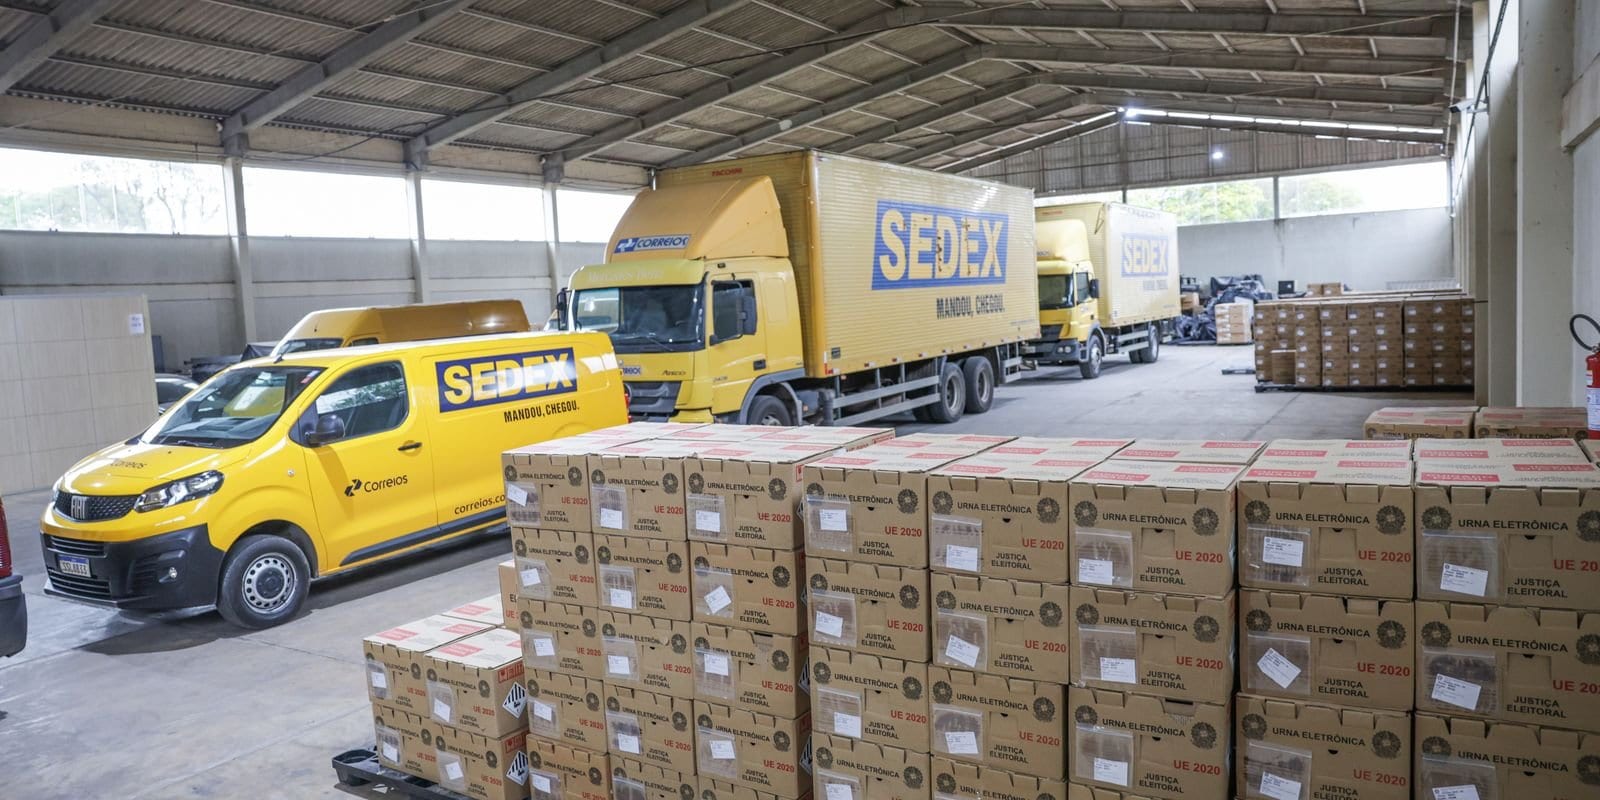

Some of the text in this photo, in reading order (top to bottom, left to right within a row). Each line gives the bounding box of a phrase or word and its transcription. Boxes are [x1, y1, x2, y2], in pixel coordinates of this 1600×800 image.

[636, 236, 690, 249] CORREIOS
[880, 209, 1003, 281] SEDEX
[1122, 239, 1168, 273] SEDEX
[936, 294, 1005, 319] MANDOU, CHEGOU.
[444, 352, 572, 405] SEDEX
[504, 400, 580, 423] MANDOU, CHEGOU.
[520, 472, 533, 480] URNA
[364, 474, 408, 493] Correios
[624, 479, 659, 487] ELETRÔNICA
[708, 482, 765, 492] URNA ELETRÔNICA
[454, 494, 506, 515] correios.co
[572, 497, 588, 505] 2020
[849, 494, 893, 504] ELETRÔNICA
[71, 496, 86, 519] FIAT
[666, 506, 683, 515] 2020
[957, 502, 1032, 514] URNA ELETRÔNICA
[759, 512, 791, 523] UE 2020
[1103, 512, 1187, 525] URNA ELETRÔNICA
[1276, 512, 1370, 524] URNA ELETRÔNICA
[634, 524, 661, 532] ELEITORAL
[738, 525, 762, 533] JUSTIÇA
[1458, 519, 1568, 531] URNA ELETRÔNICA
[735, 532, 766, 540] ELEITORAL
[885, 527, 922, 537] UE 2020
[863, 541, 890, 549] JUSTIÇA
[1022, 538, 1064, 550] UE 2020
[859, 548, 894, 557] ELEITORAL
[996, 552, 1027, 561] JUSTIÇA
[1176, 551, 1223, 563] UE 2020
[1359, 551, 1411, 563] UE 2020
[992, 560, 1031, 570] ELEITORAL
[1146, 566, 1181, 576] JUSTIÇA
[1554, 560, 1600, 572] UE 20
[730, 567, 769, 579] ELETRÔNICA
[1324, 567, 1363, 578] JUSTIÇA
[1140, 574, 1185, 585] ELEITORAL
[1318, 576, 1369, 586] ELEITORAL
[1514, 578, 1560, 588] JUSTIÇA
[659, 583, 687, 593] UE 2020
[831, 585, 895, 599] URNA ELETRÔNICA
[1508, 587, 1567, 598] ELEITORAL
[763, 597, 794, 609] UE 2020
[744, 609, 767, 618] JUSTIÇA
[960, 602, 1034, 617] URNA ELETRÔNICA
[740, 616, 770, 625] ELEITORAL
[887, 619, 923, 632] UE 2020
[1104, 616, 1188, 632] URNA ELETRÔNICA
[1277, 622, 1370, 638] URNA ELETRÔNICA
[865, 632, 891, 642] JUSTIÇA
[861, 639, 896, 650] ELEITORAL
[1025, 640, 1067, 653] UE 2020
[1457, 635, 1568, 652] URNA ELETRÔNICA
[999, 652, 1030, 663] JUSTIÇA
[1176, 656, 1223, 670] UE 2020
[994, 660, 1034, 672] ELEITORAL
[1358, 662, 1410, 677] UE 2020
[835, 673, 898, 690] URNA ELETRÔNICA
[1147, 670, 1181, 681] JUSTIÇA
[1141, 678, 1187, 690] ELEITORAL
[1324, 678, 1363, 689] JUSTIÇA
[1553, 680, 1575, 691] UE
[1319, 685, 1369, 698] ELEITORAL
[957, 693, 1028, 711] URNA ELETRÔNICA
[1514, 695, 1560, 708] JUSTIÇA
[891, 710, 926, 723] UE 2020
[1507, 704, 1567, 718] ELEITORAL
[716, 725, 731, 734] URNA
[868, 721, 895, 731] JUSTIÇA
[1102, 718, 1186, 738] URNA ELETRÔNICA
[865, 727, 899, 739] ELEITORAL
[1019, 731, 1060, 746] UE 2020
[1273, 728, 1366, 747] URNA ELETRÔNICA
[993, 744, 1024, 755] JUSTIÇA
[990, 750, 1029, 764] ELEITORAL
[1458, 750, 1568, 772] URNA ELETRÔNICA
[764, 760, 794, 773] UE 2020
[837, 759, 899, 779] URNA ELETRÔNICA
[1174, 760, 1221, 776] UE 2020
[1145, 773, 1179, 785] JUSTIÇA
[1353, 769, 1406, 787] UE 2020
[1139, 780, 1184, 794] ELEITORAL
[1320, 784, 1358, 796] JUSTIÇA
